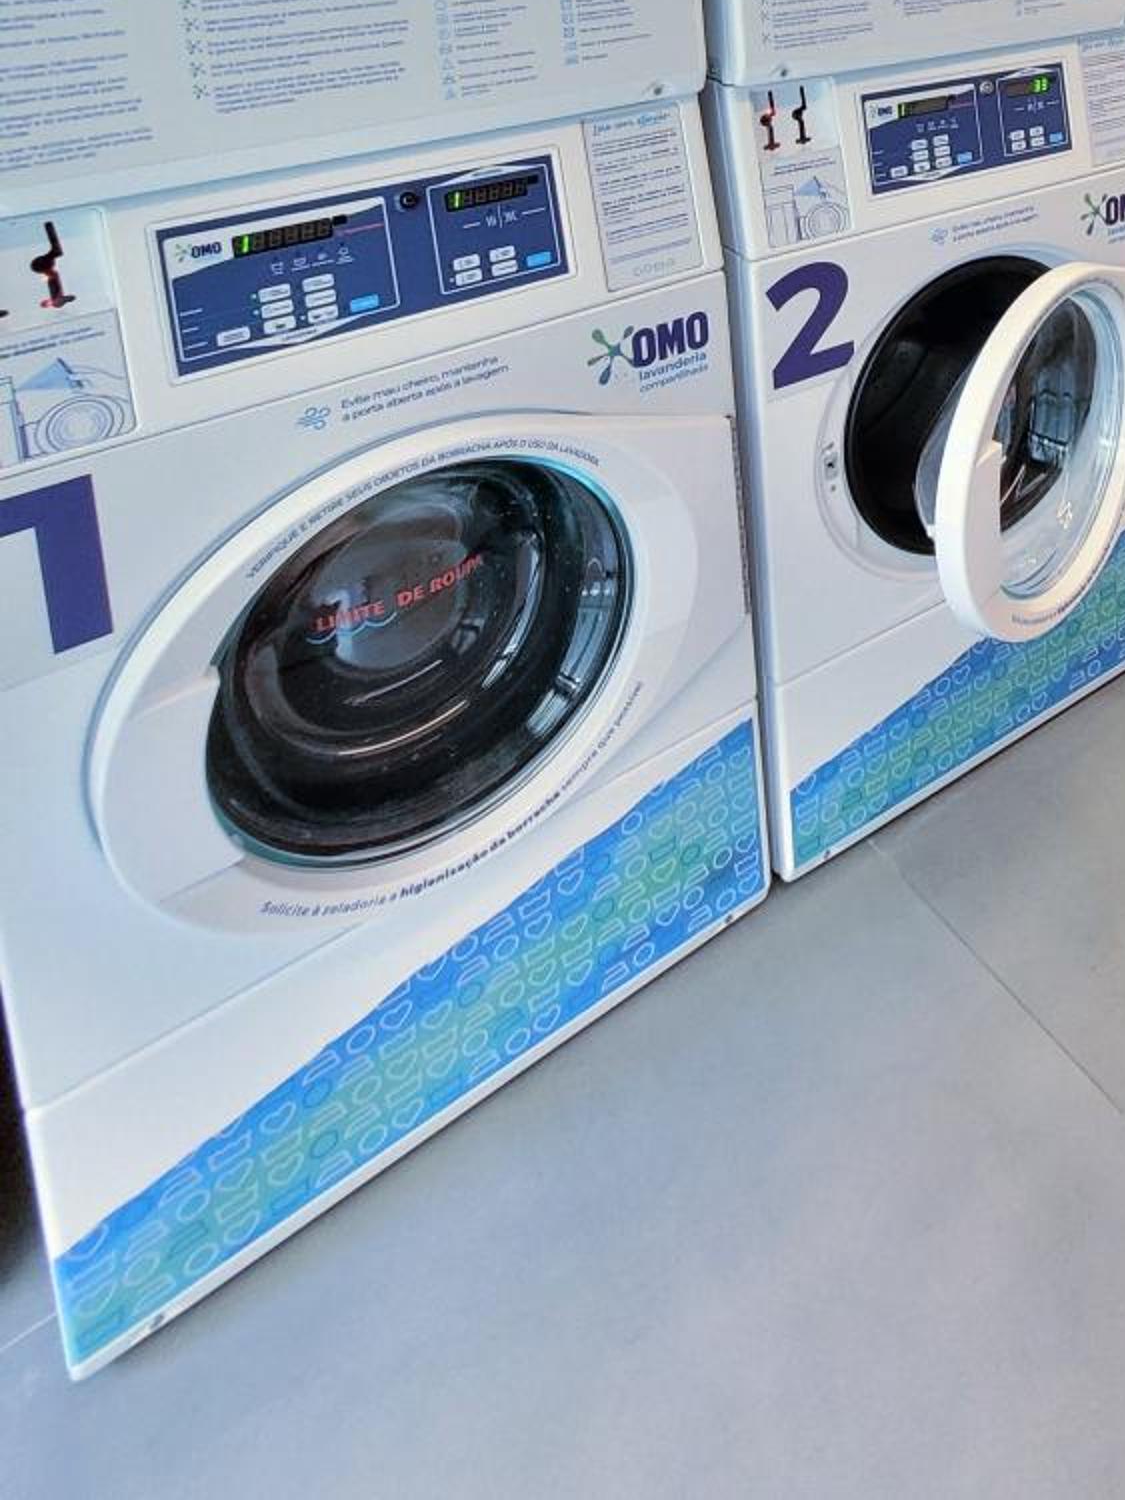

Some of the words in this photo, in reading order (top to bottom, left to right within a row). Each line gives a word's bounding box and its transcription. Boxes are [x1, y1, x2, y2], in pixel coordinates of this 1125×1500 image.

[191, 241, 223, 258] OMO
[632, 311, 709, 368] OMO
[765, 261, 855, 390] 2
[341, 391, 371, 409] Evite
[441, 356, 499, 379] mantenha
[640, 352, 707, 380] lavanderia
[351, 403, 384, 421] porta
[0, 474, 114, 655] 1
[316, 600, 385, 631] LIMITE
[397, 585, 424, 606] DE
[261, 900, 307, 916] Solicite
[400, 848, 489, 897] higienização
[490, 836, 505, 851] da
